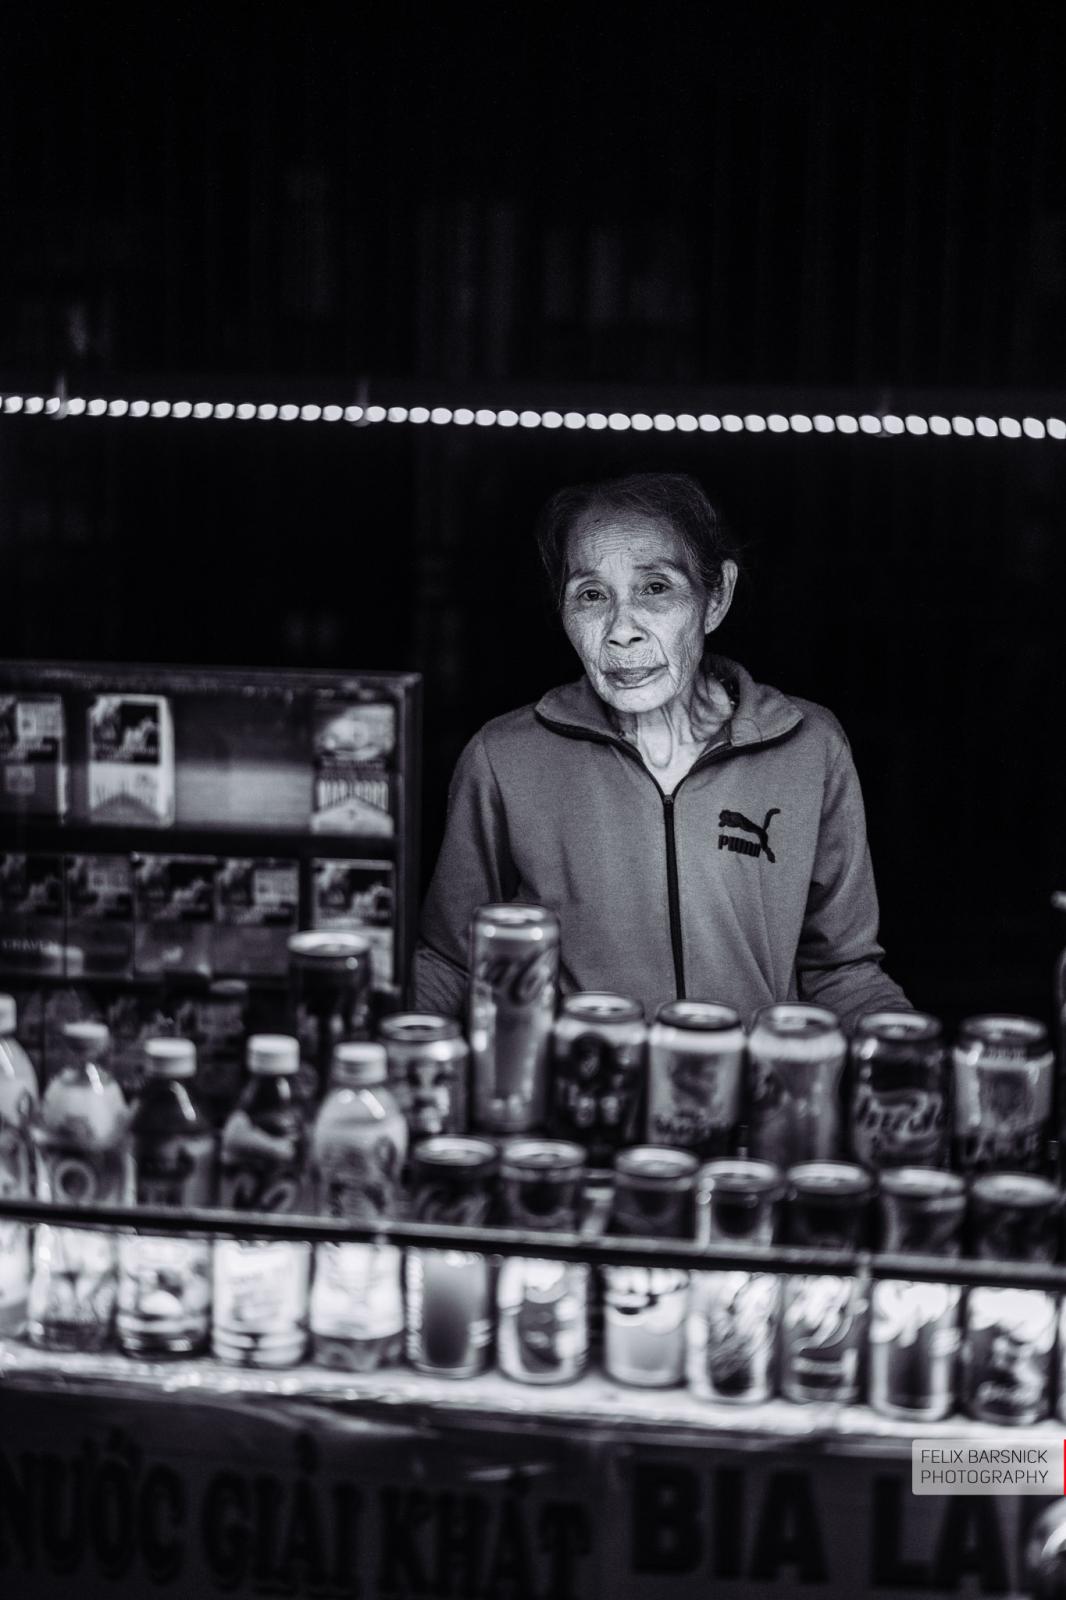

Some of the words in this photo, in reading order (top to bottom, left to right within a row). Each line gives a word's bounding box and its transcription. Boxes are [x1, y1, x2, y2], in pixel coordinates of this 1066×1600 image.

[718, 835, 761, 857] PUMA
[631, 1462, 830, 1583] BIA
[871, 1470, 1056, 1597] LA
